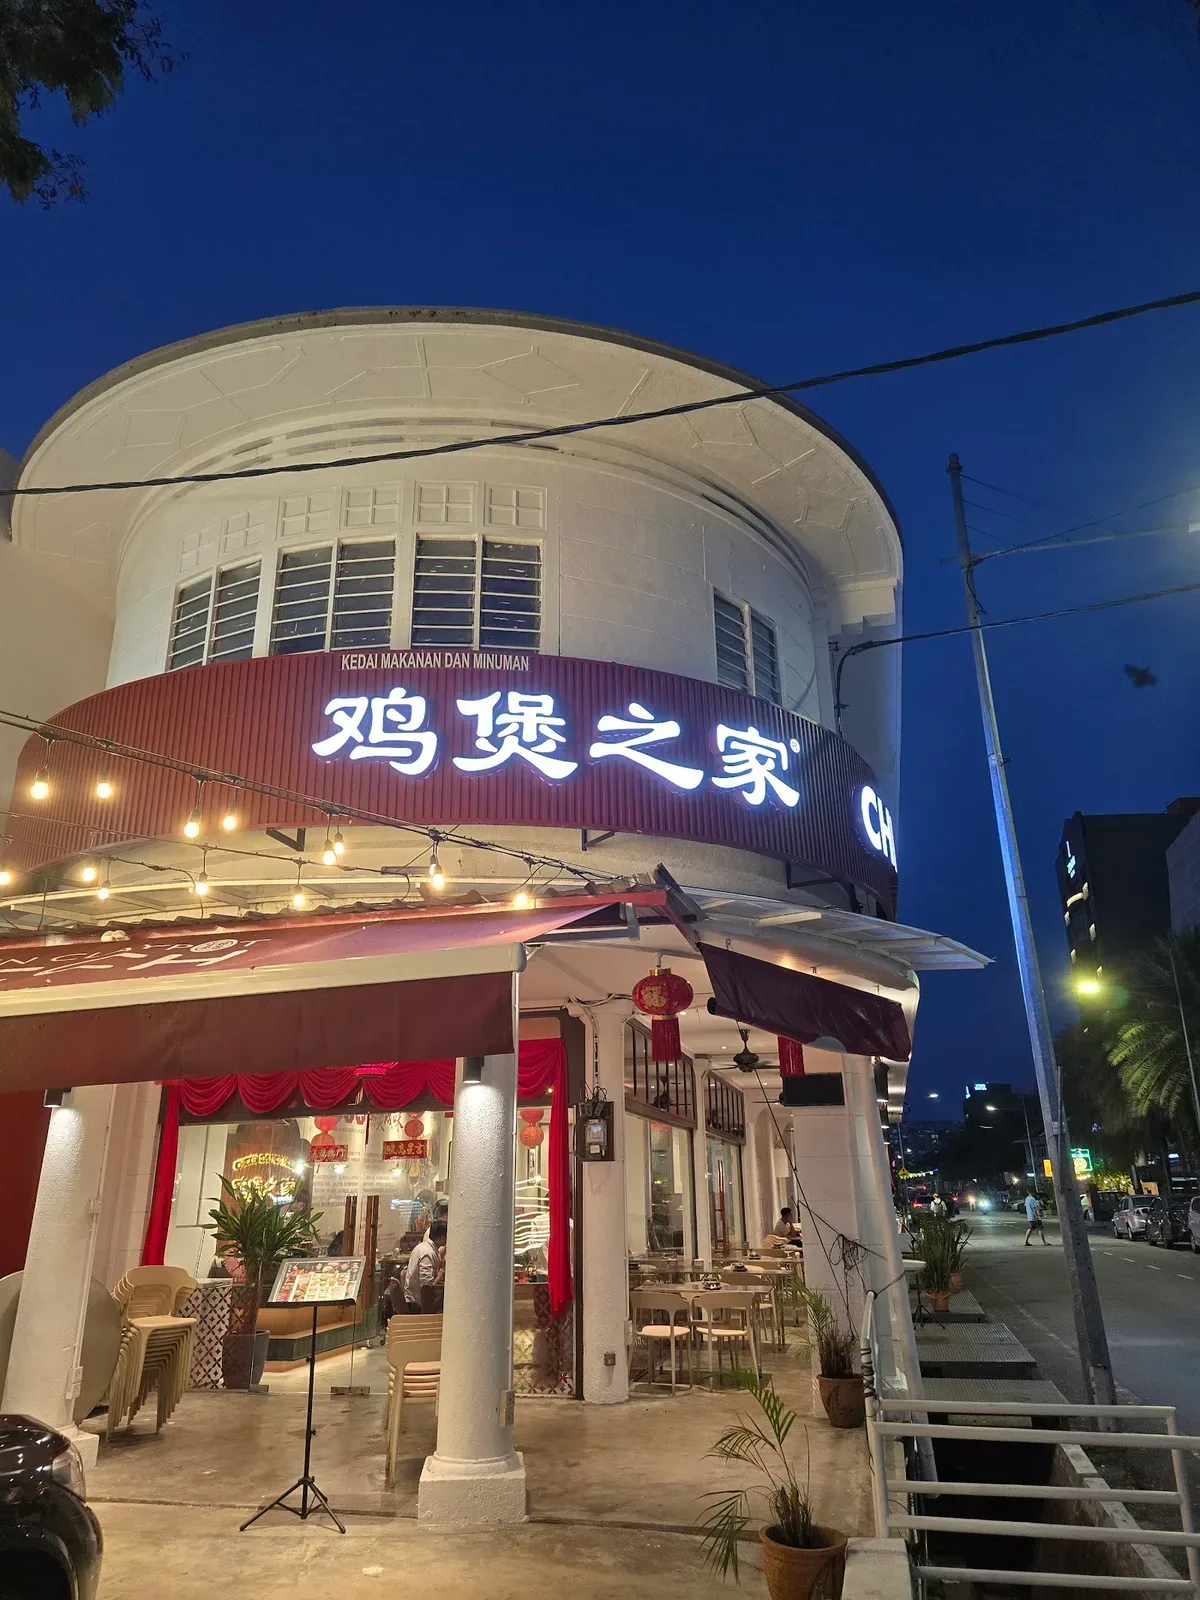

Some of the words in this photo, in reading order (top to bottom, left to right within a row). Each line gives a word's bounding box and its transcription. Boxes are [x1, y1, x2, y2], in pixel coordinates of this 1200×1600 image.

[341, 654, 378, 670] KEDAI
[381, 653, 441, 669] MAKANAN
[444, 653, 470, 668] DAN
[473, 654, 530, 671] MINUMAN
[312, 687, 800, 808] 鸡煲之家
